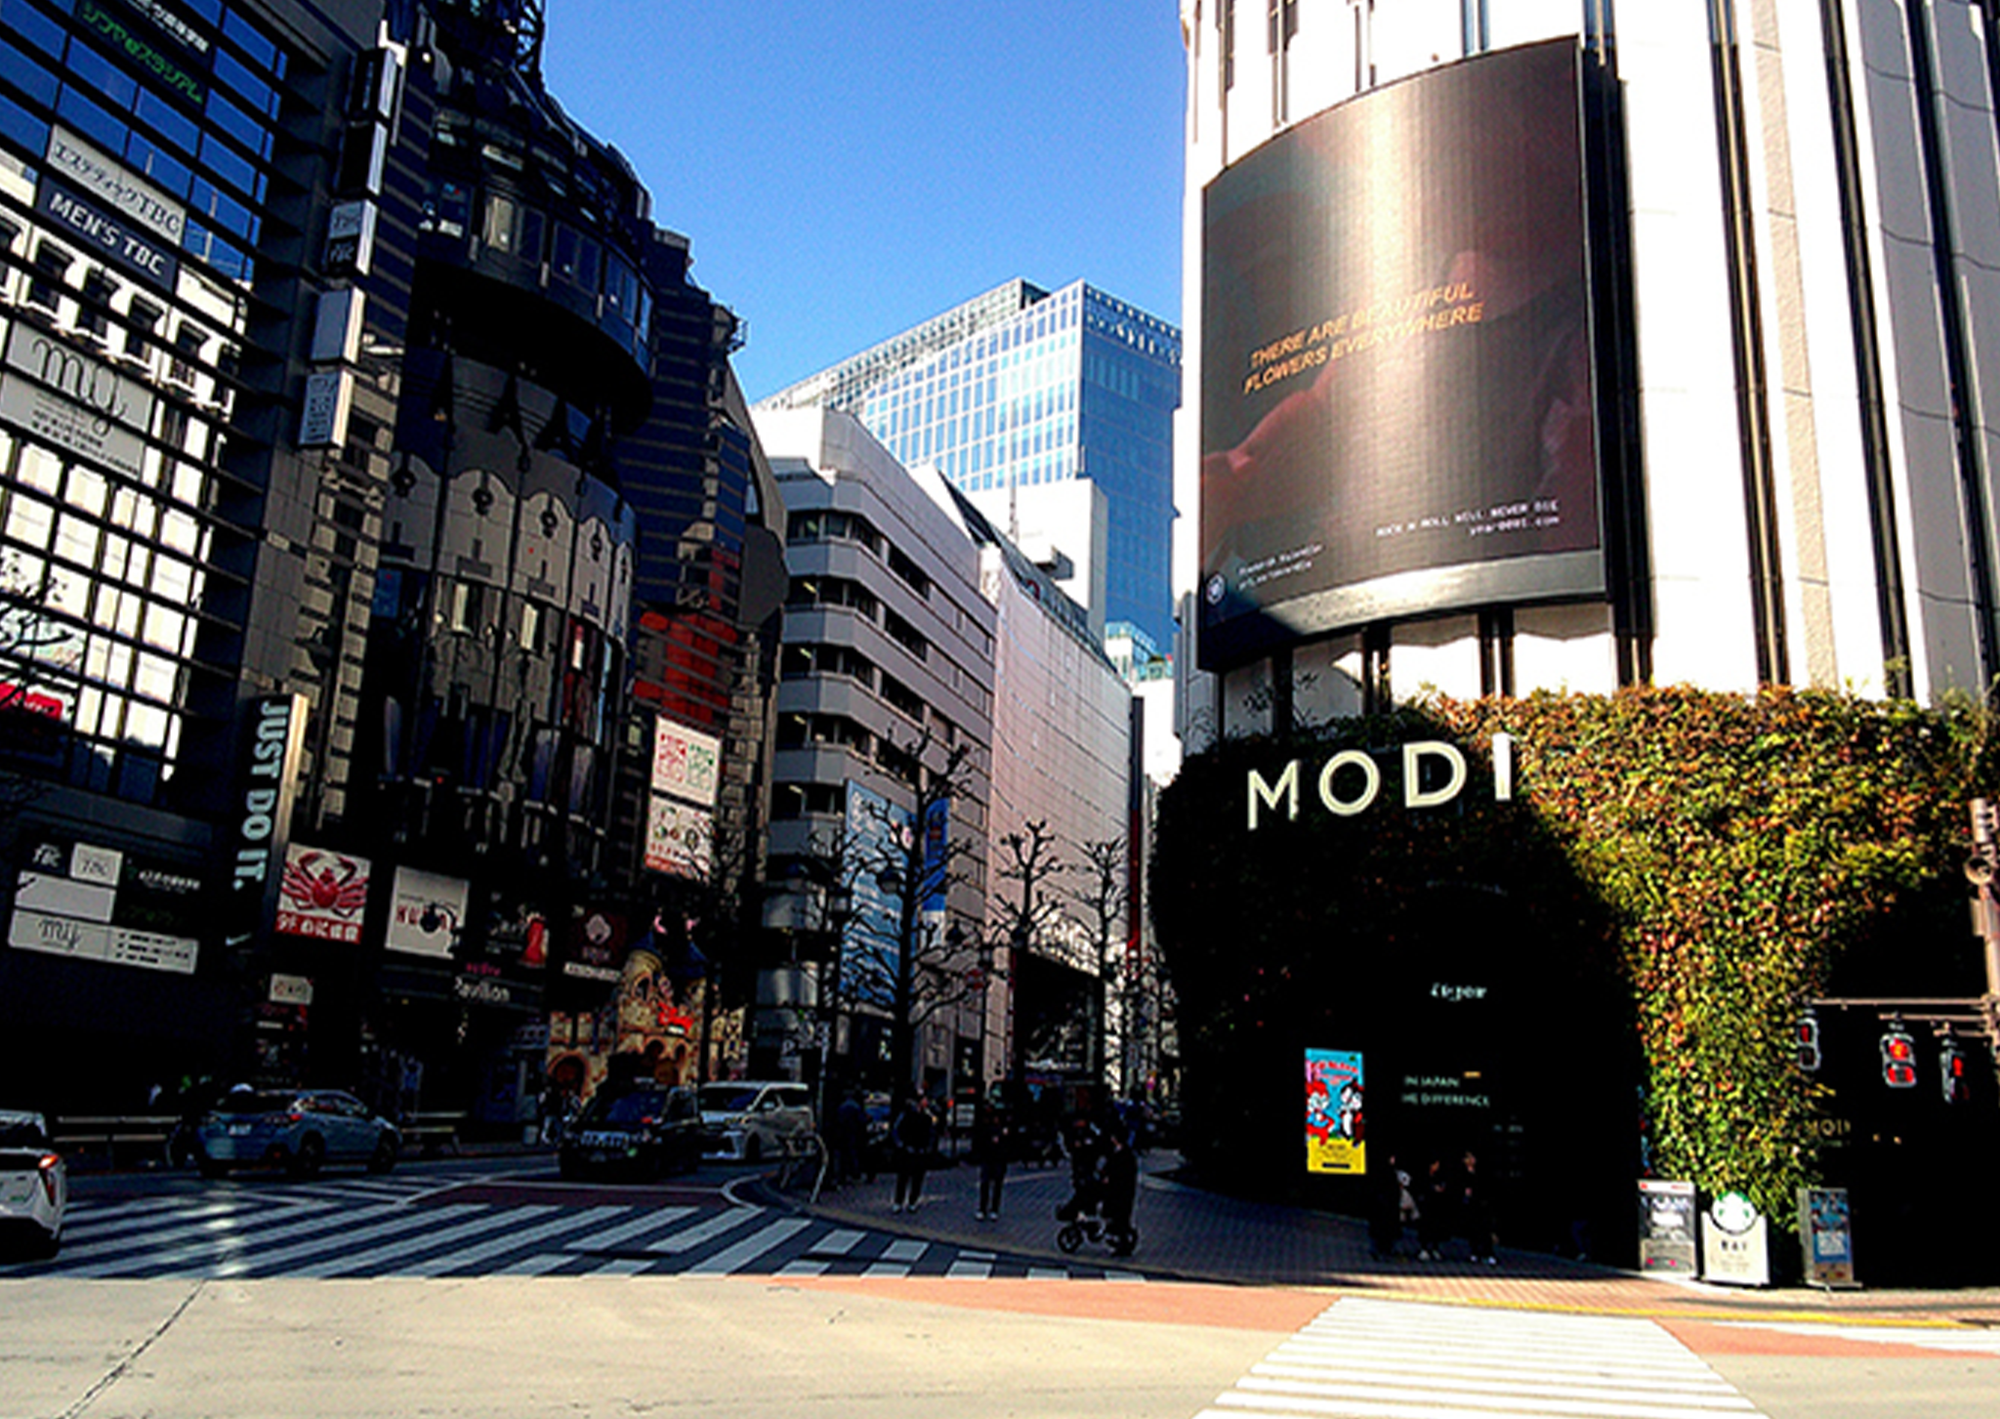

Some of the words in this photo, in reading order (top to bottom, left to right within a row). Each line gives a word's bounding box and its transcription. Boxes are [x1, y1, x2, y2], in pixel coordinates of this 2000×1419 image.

[49, 192, 121, 248] MEN'S
[123, 234, 166, 276] TBC
[1243, 347, 1329, 394] FLOWERS
[1331, 302, 1485, 360] EVERYWHERE
[1250, 331, 1306, 367] THERE
[1307, 314, 1349, 344] ARE
[1352, 283, 1475, 328] BEAUTIFUL
[249, 701, 290, 780] JUST
[1246, 732, 1516, 831] MODI
[241, 790, 277, 839] DO
[231, 848, 271, 891] IT.
